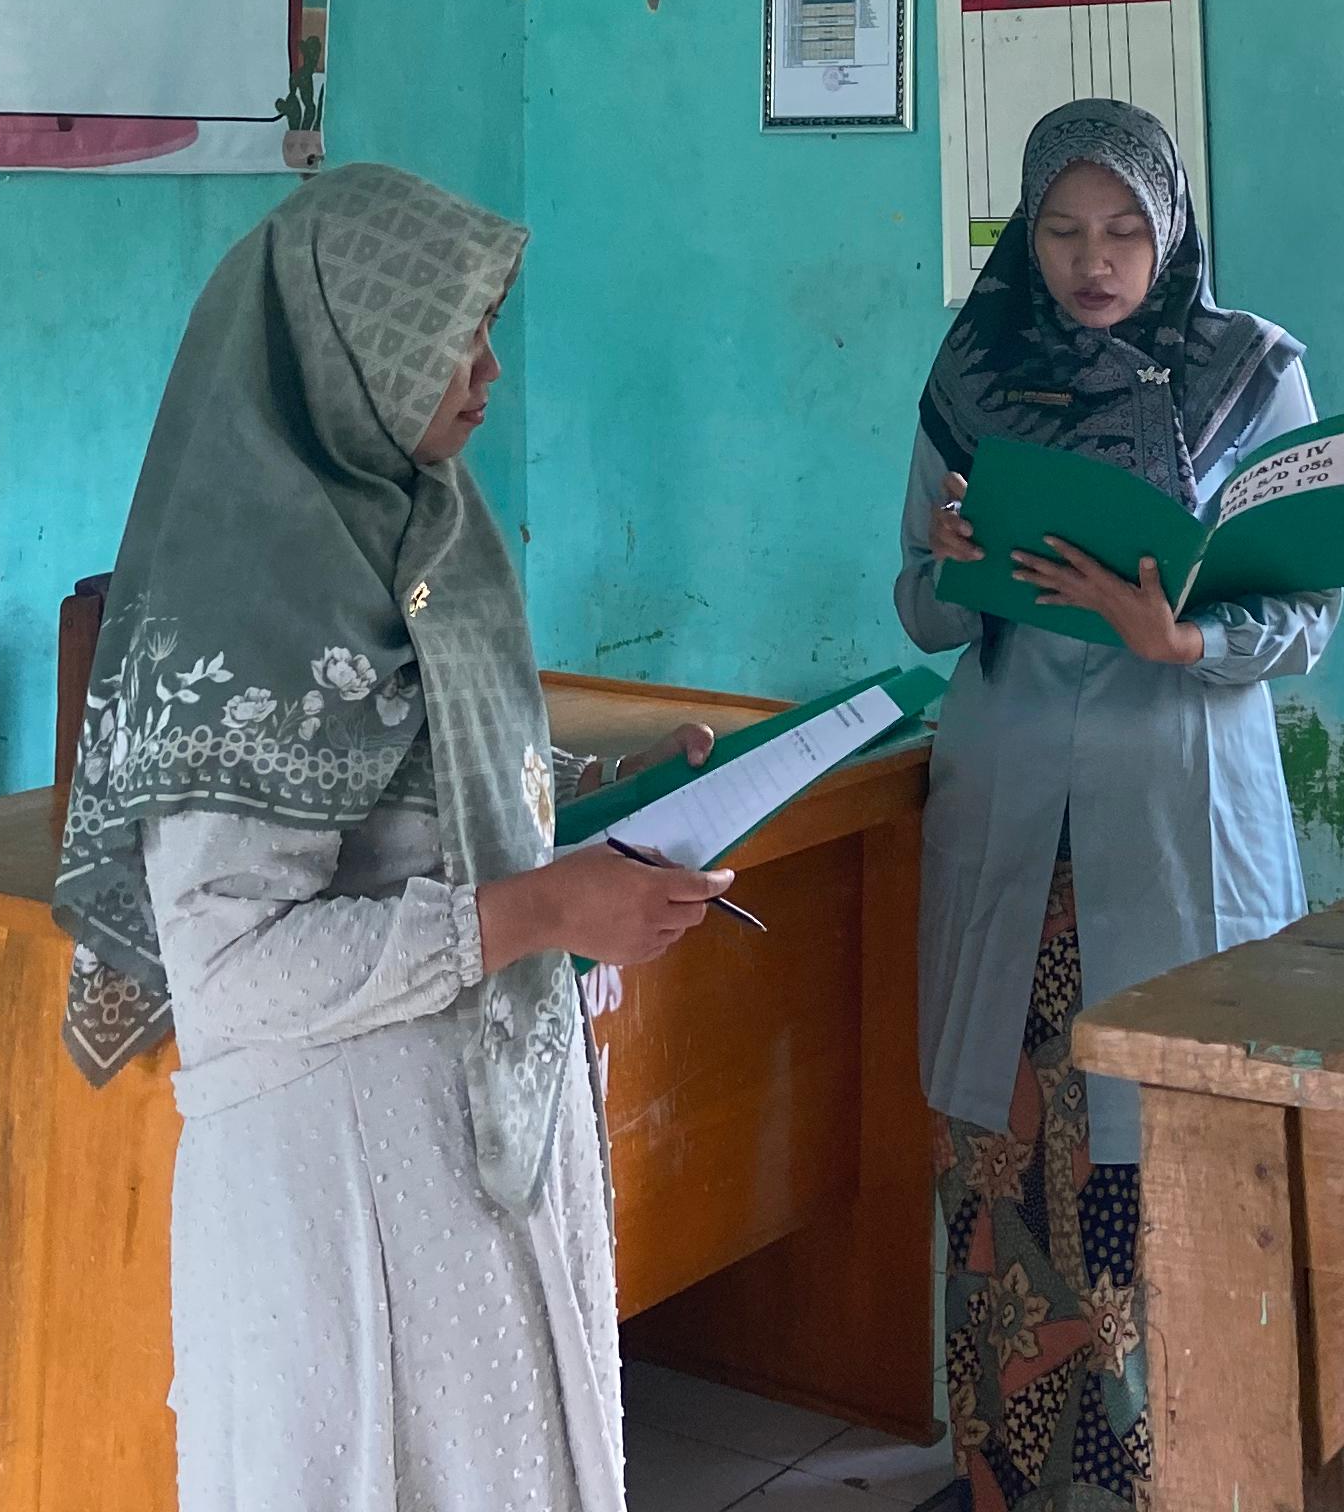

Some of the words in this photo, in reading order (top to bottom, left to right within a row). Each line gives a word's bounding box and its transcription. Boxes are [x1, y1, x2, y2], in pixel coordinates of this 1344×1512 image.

[1229, 453, 1299, 494] RUANG
[1306, 441, 1332, 458] IV
[1257, 470, 1289, 488] S/D
[1252, 485, 1284, 502] S/D
[1296, 472, 1329, 487] 170
